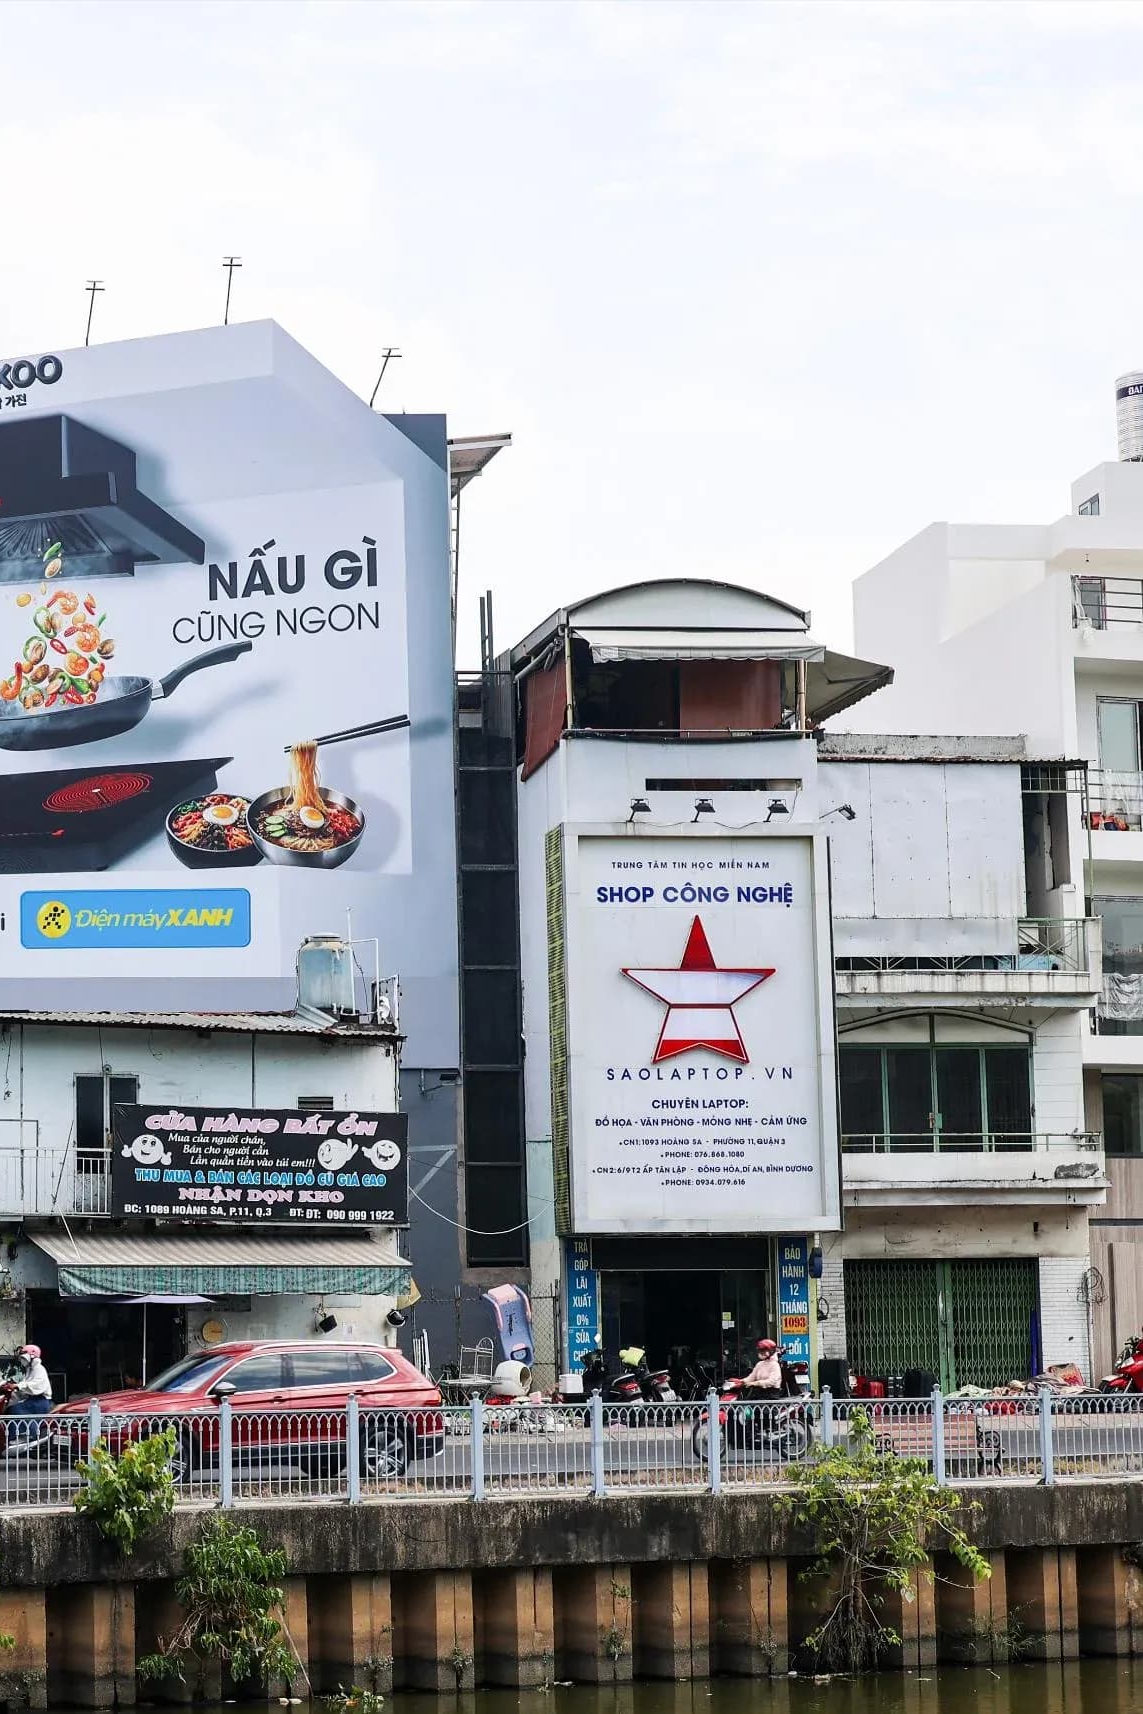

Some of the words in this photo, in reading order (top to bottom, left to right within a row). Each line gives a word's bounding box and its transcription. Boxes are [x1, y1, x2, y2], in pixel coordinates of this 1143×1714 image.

[5, 394, 27, 408] 가전
[208, 538, 306, 601] NẤU
[324, 535, 378, 590] GÌ
[172, 610, 266, 644] CŨNG
[276, 601, 380, 636] NGON
[611, 861, 643, 869] TRUNG
[648, 859, 668, 869] TÂM
[672, 861, 687, 869] TIN
[691, 861, 714, 871] HỌC
[719, 858, 743, 869] MIỀN
[747, 861, 770, 869] NAM
[597, 886, 654, 903] SHOP
[662, 882, 730, 903] CÔNG
[737, 882, 793, 908] NGHỆ
[75, 909, 120, 931] Điện
[651, 1097, 699, 1109] CHUYÊN
[702, 1099, 749, 1109] LAPTOP:
[144, 1109, 197, 1132] CỬA
[201, 1112, 280, 1134] HÀNG
[283, 1113, 336, 1135] BẤT
[337, 1112, 379, 1136] ỔN
[595, 1115, 610, 1127] ĐỒ
[612, 1118, 633, 1128] HỌA
[640, 1116, 659, 1127] VĂN
[661, 1116, 695, 1127] PHÒNG
[735, 1117, 753, 1127] NHẸ
[761, 1114, 783, 1125] CẢM
[786, 1114, 808, 1125] ỨNG
[168, 1132, 190, 1142] Mua
[192, 1133, 209, 1143] của
[212, 1133, 238, 1145] người
[183, 1144, 202, 1154] Bán
[204, 1145, 220, 1154] cho
[222, 1145, 249, 1156] người
[257, 1157, 274, 1167] vào
[275, 1158, 289, 1167] túi
[291, 1158, 315, 1168] em!!!
[642, 1163, 653, 1173] ẤP
[766, 1163, 784, 1173] BÌNH
[135, 1167, 160, 1182] THU
[163, 1169, 193, 1183] MUA
[194, 1169, 206, 1183] &
[208, 1168, 235, 1184] BÁN
[237, 1169, 261, 1185] CÁC
[263, 1172, 293, 1188] LOẠI
[295, 1169, 315, 1186] ĐỒ
[337, 1171, 360, 1187] GIÁ
[362, 1173, 387, 1187] CAO
[178, 1185, 243, 1204] NHẬN
[246, 1189, 294, 1205] DỌN
[298, 1190, 345, 1203] KHO
[124, 1204, 142, 1213] ĐC:
[144, 1204, 170, 1214] 1089
[172, 1204, 208, 1215] HOÀNG
[210, 1206, 227, 1216] SA,
[255, 1207, 272, 1217] Q.3
[289, 1208, 304, 1217] ĐT:
[306, 1209, 321, 1219] ĐT:
[326, 1209, 346, 1220] 090
[348, 1210, 367, 1220] 999
[369, 1210, 395, 1220] 1922
[574, 1259, 589, 1271] GÓP
[782, 1263, 804, 1278] HÀNH
[789, 1283, 799, 1296] 12
[572, 1292, 592, 1308] XUẤT
[781, 1299, 807, 1314] THÁNG
[783, 1316, 806, 1328] 1093
